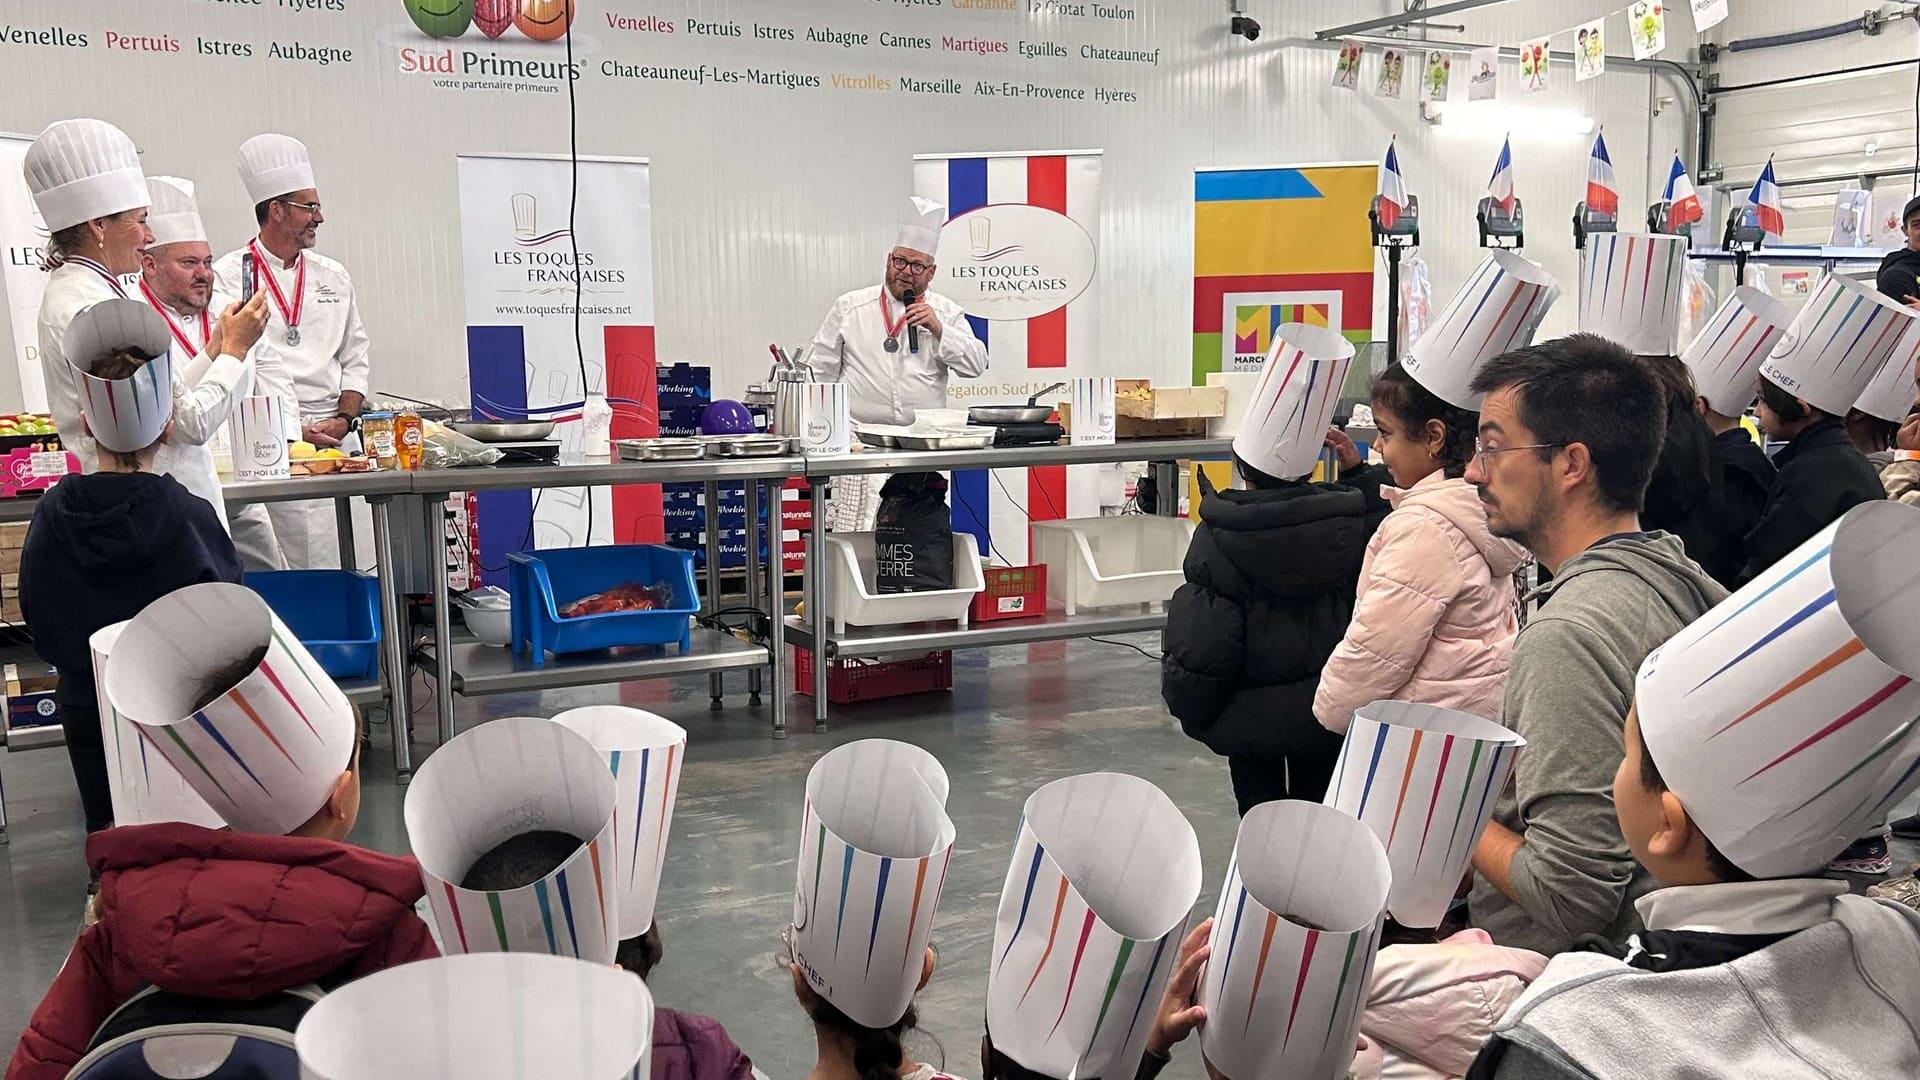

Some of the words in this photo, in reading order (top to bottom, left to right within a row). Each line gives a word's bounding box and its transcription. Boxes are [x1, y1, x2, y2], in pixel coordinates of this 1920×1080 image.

[1092, 4, 1135, 20] Toulon
[0, 26, 88, 48] Venelles
[105, 31, 181, 53] Pertuis
[196, 37, 252, 57] Istres
[268, 41, 353, 66] Aubagne
[606, 12, 675, 34] Venelles
[687, 18, 742, 38] Pertuis
[753, 23, 795, 41] Istres
[806, 26, 869, 47] Aubagne
[879, 31, 932, 50] Cannes
[942, 37, 1009, 56] Martigues
[1018, 41, 1068, 58] Eguilles
[1080, 44, 1160, 66] Chateauneuf
[399, 47, 454, 74] Sud
[433, 80, 460, 90] votre
[462, 80, 513, 92] partenaire
[515, 82, 559, 95] primeurs
[600, 60, 820, 90] Chateauneuf-Les-Martigues
[830, 73, 892, 91] Vitrolles
[899, 77, 962, 95] Marseille
[974, 80, 1085, 101] Aix-En-Provence
[1094, 87, 1137, 104] Hyères
[494, 251, 522, 265] LES
[527, 251, 594, 268] TOQUES
[528, 269, 625, 285] FRANÇAISES
[952, 266, 976, 278] LES
[980, 265, 1040, 280] TOQUES
[980, 279, 1067, 294] FRANÇAISES
[1772, 369, 1796, 387] CHEF
[1001, 383, 1029, 396] Sud
[717, 504, 746, 514] Workin
[719, 543, 747, 553] Workin
[797, 952, 825, 987] CHEF
